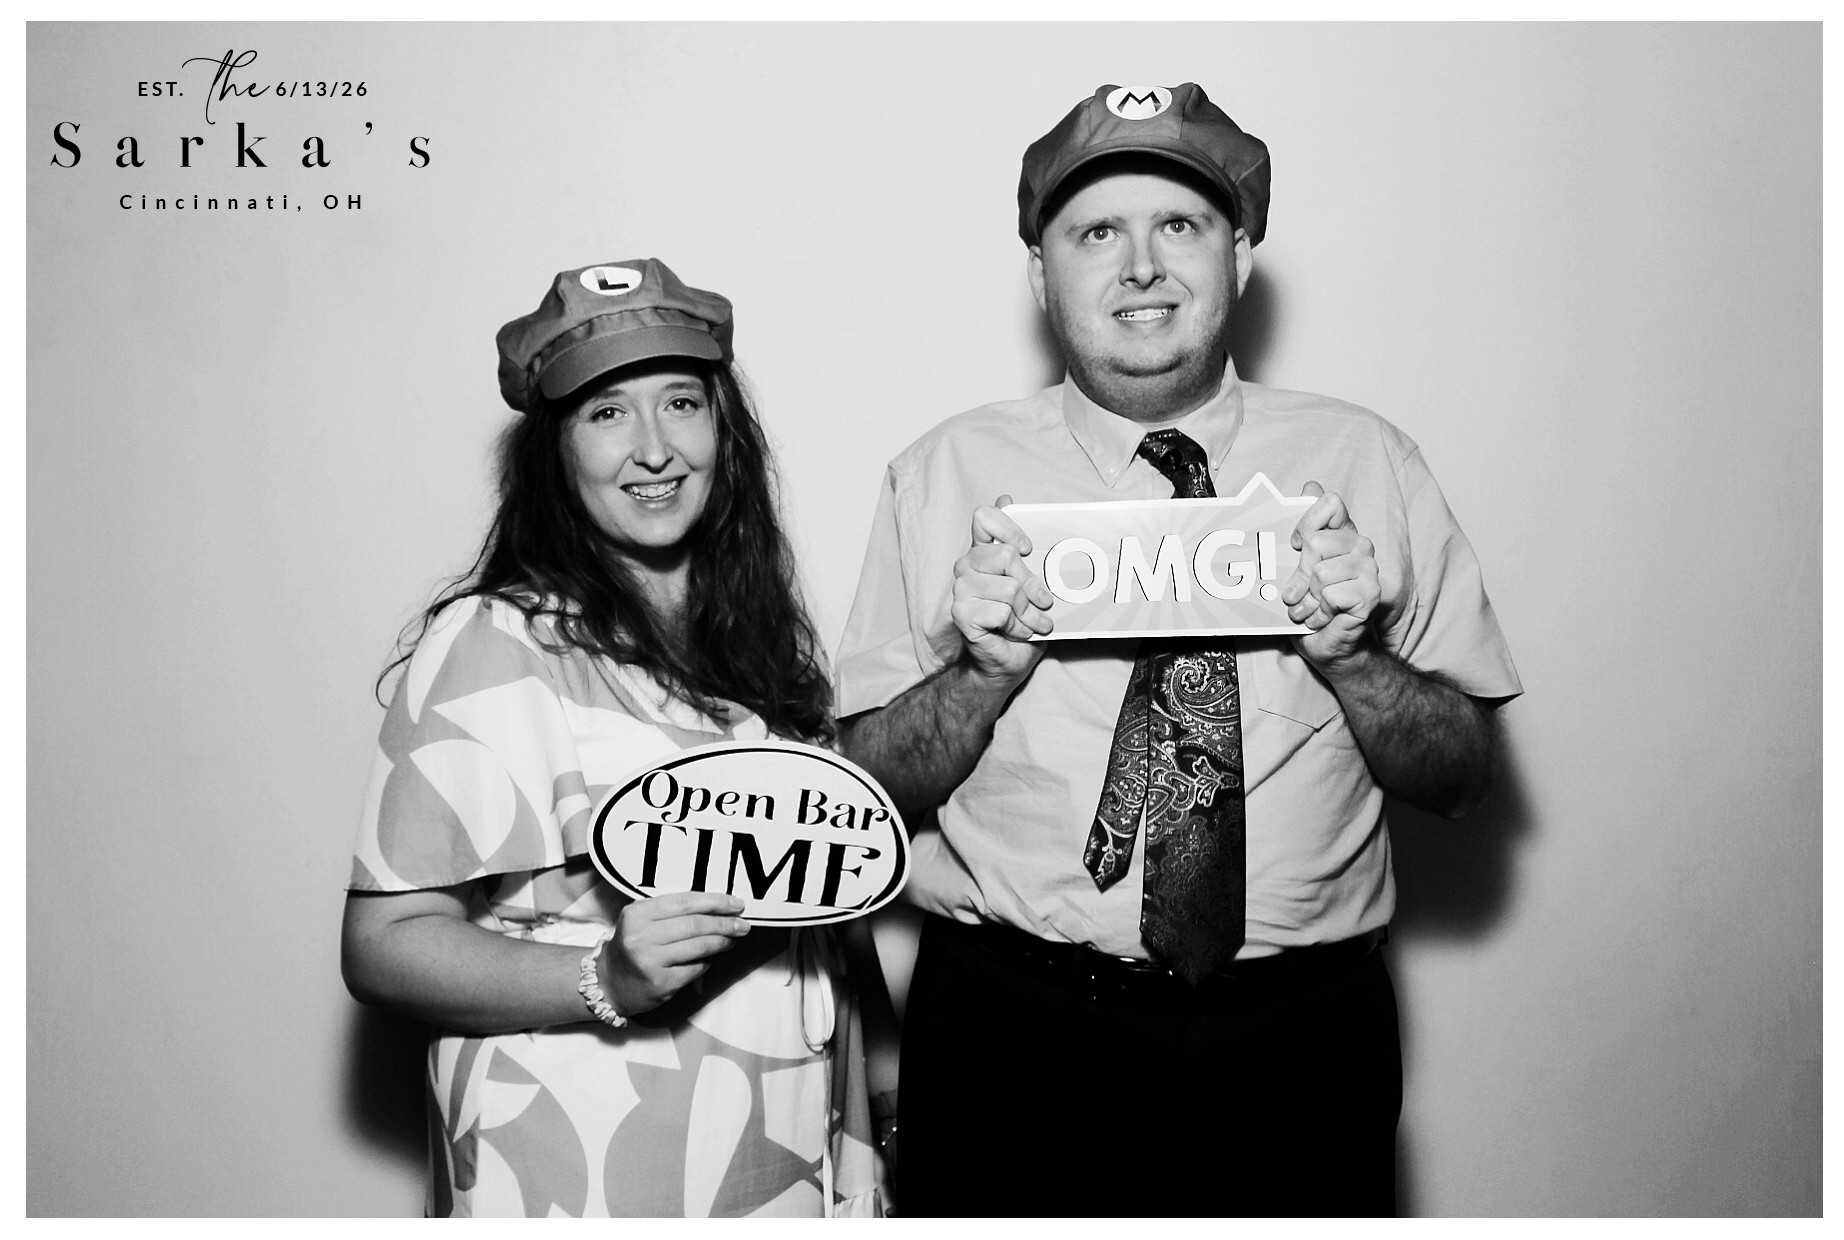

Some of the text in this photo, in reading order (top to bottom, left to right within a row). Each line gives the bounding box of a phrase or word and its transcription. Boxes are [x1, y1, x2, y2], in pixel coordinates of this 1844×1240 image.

[1116, 91, 1163, 114] M
[591, 268, 630, 291] L
[1043, 529, 1279, 605] OMG!
[641, 771, 890, 831] Open Bar
[623, 820, 882, 910] TIME
